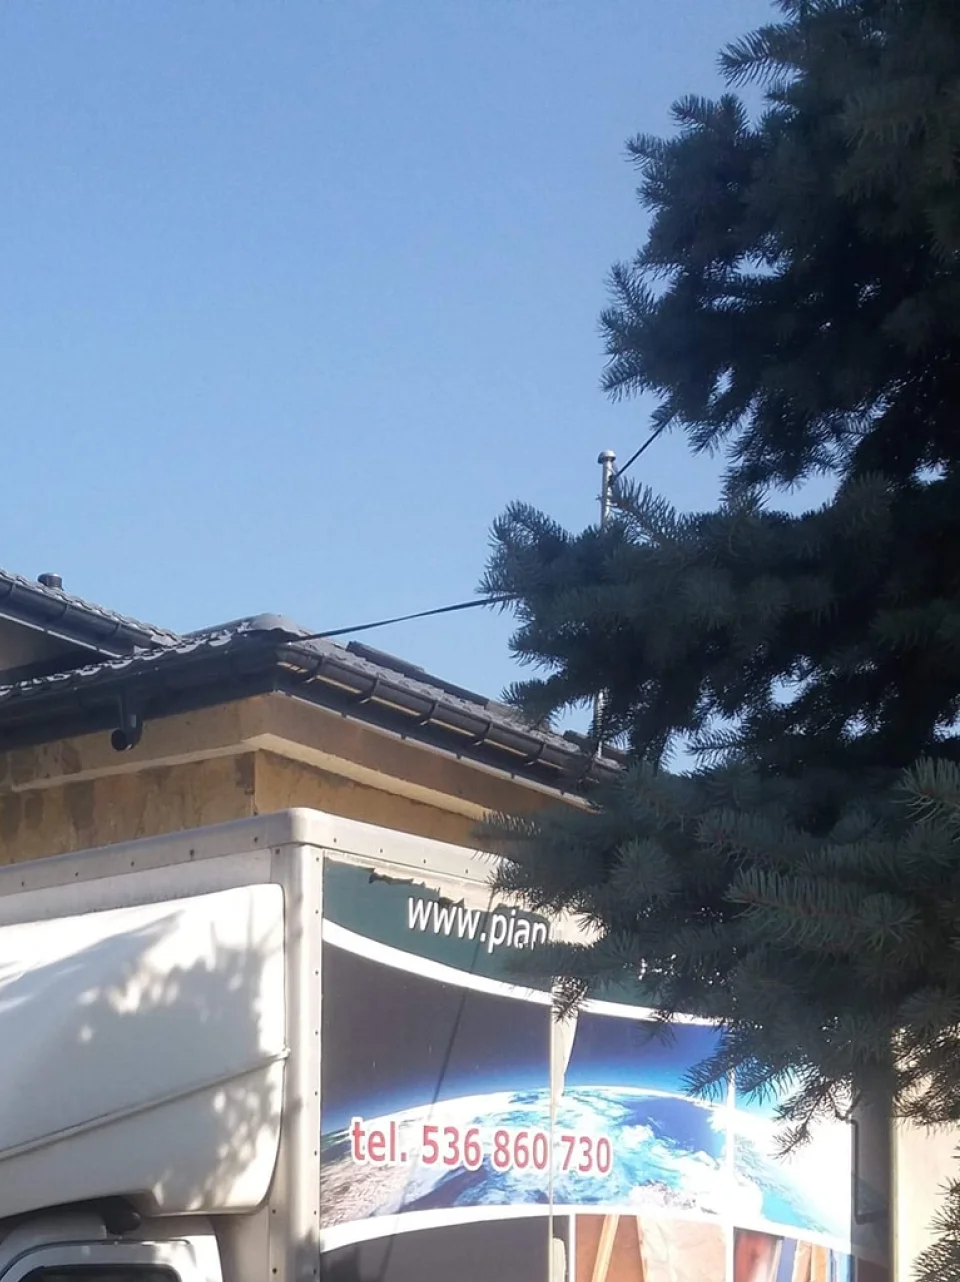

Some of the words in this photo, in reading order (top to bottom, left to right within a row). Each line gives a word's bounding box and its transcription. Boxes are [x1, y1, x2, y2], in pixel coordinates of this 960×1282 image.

[408, 897, 547, 953] www.pian
[351, 1120, 408, 1163] tel.
[421, 1125, 481, 1168] 536
[494, 1130, 548, 1170] 860
[560, 1135, 611, 1174] 730
